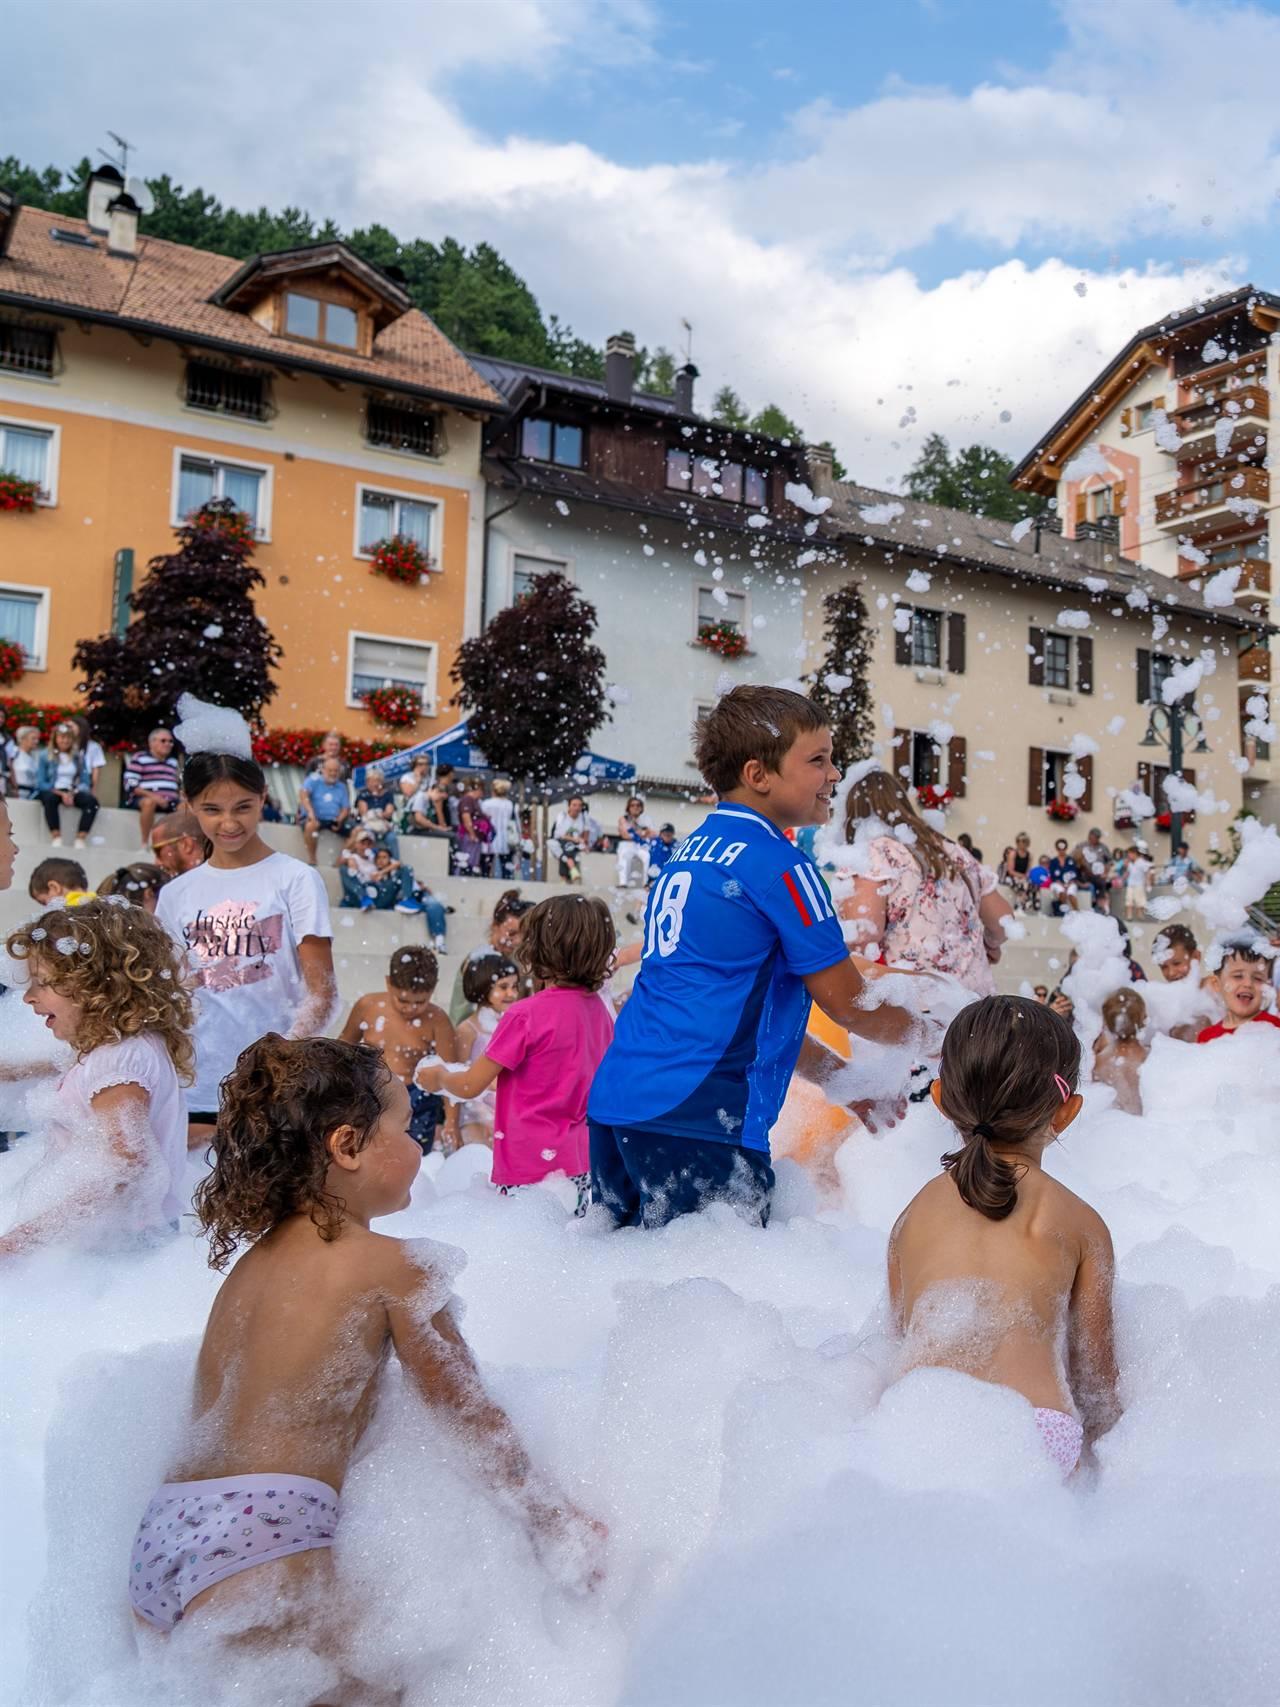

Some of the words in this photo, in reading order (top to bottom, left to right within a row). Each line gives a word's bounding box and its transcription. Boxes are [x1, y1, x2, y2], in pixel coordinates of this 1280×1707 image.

[664, 836, 748, 867] RELLA
[196, 907, 257, 930] Inside
[641, 870, 693, 960] 18
